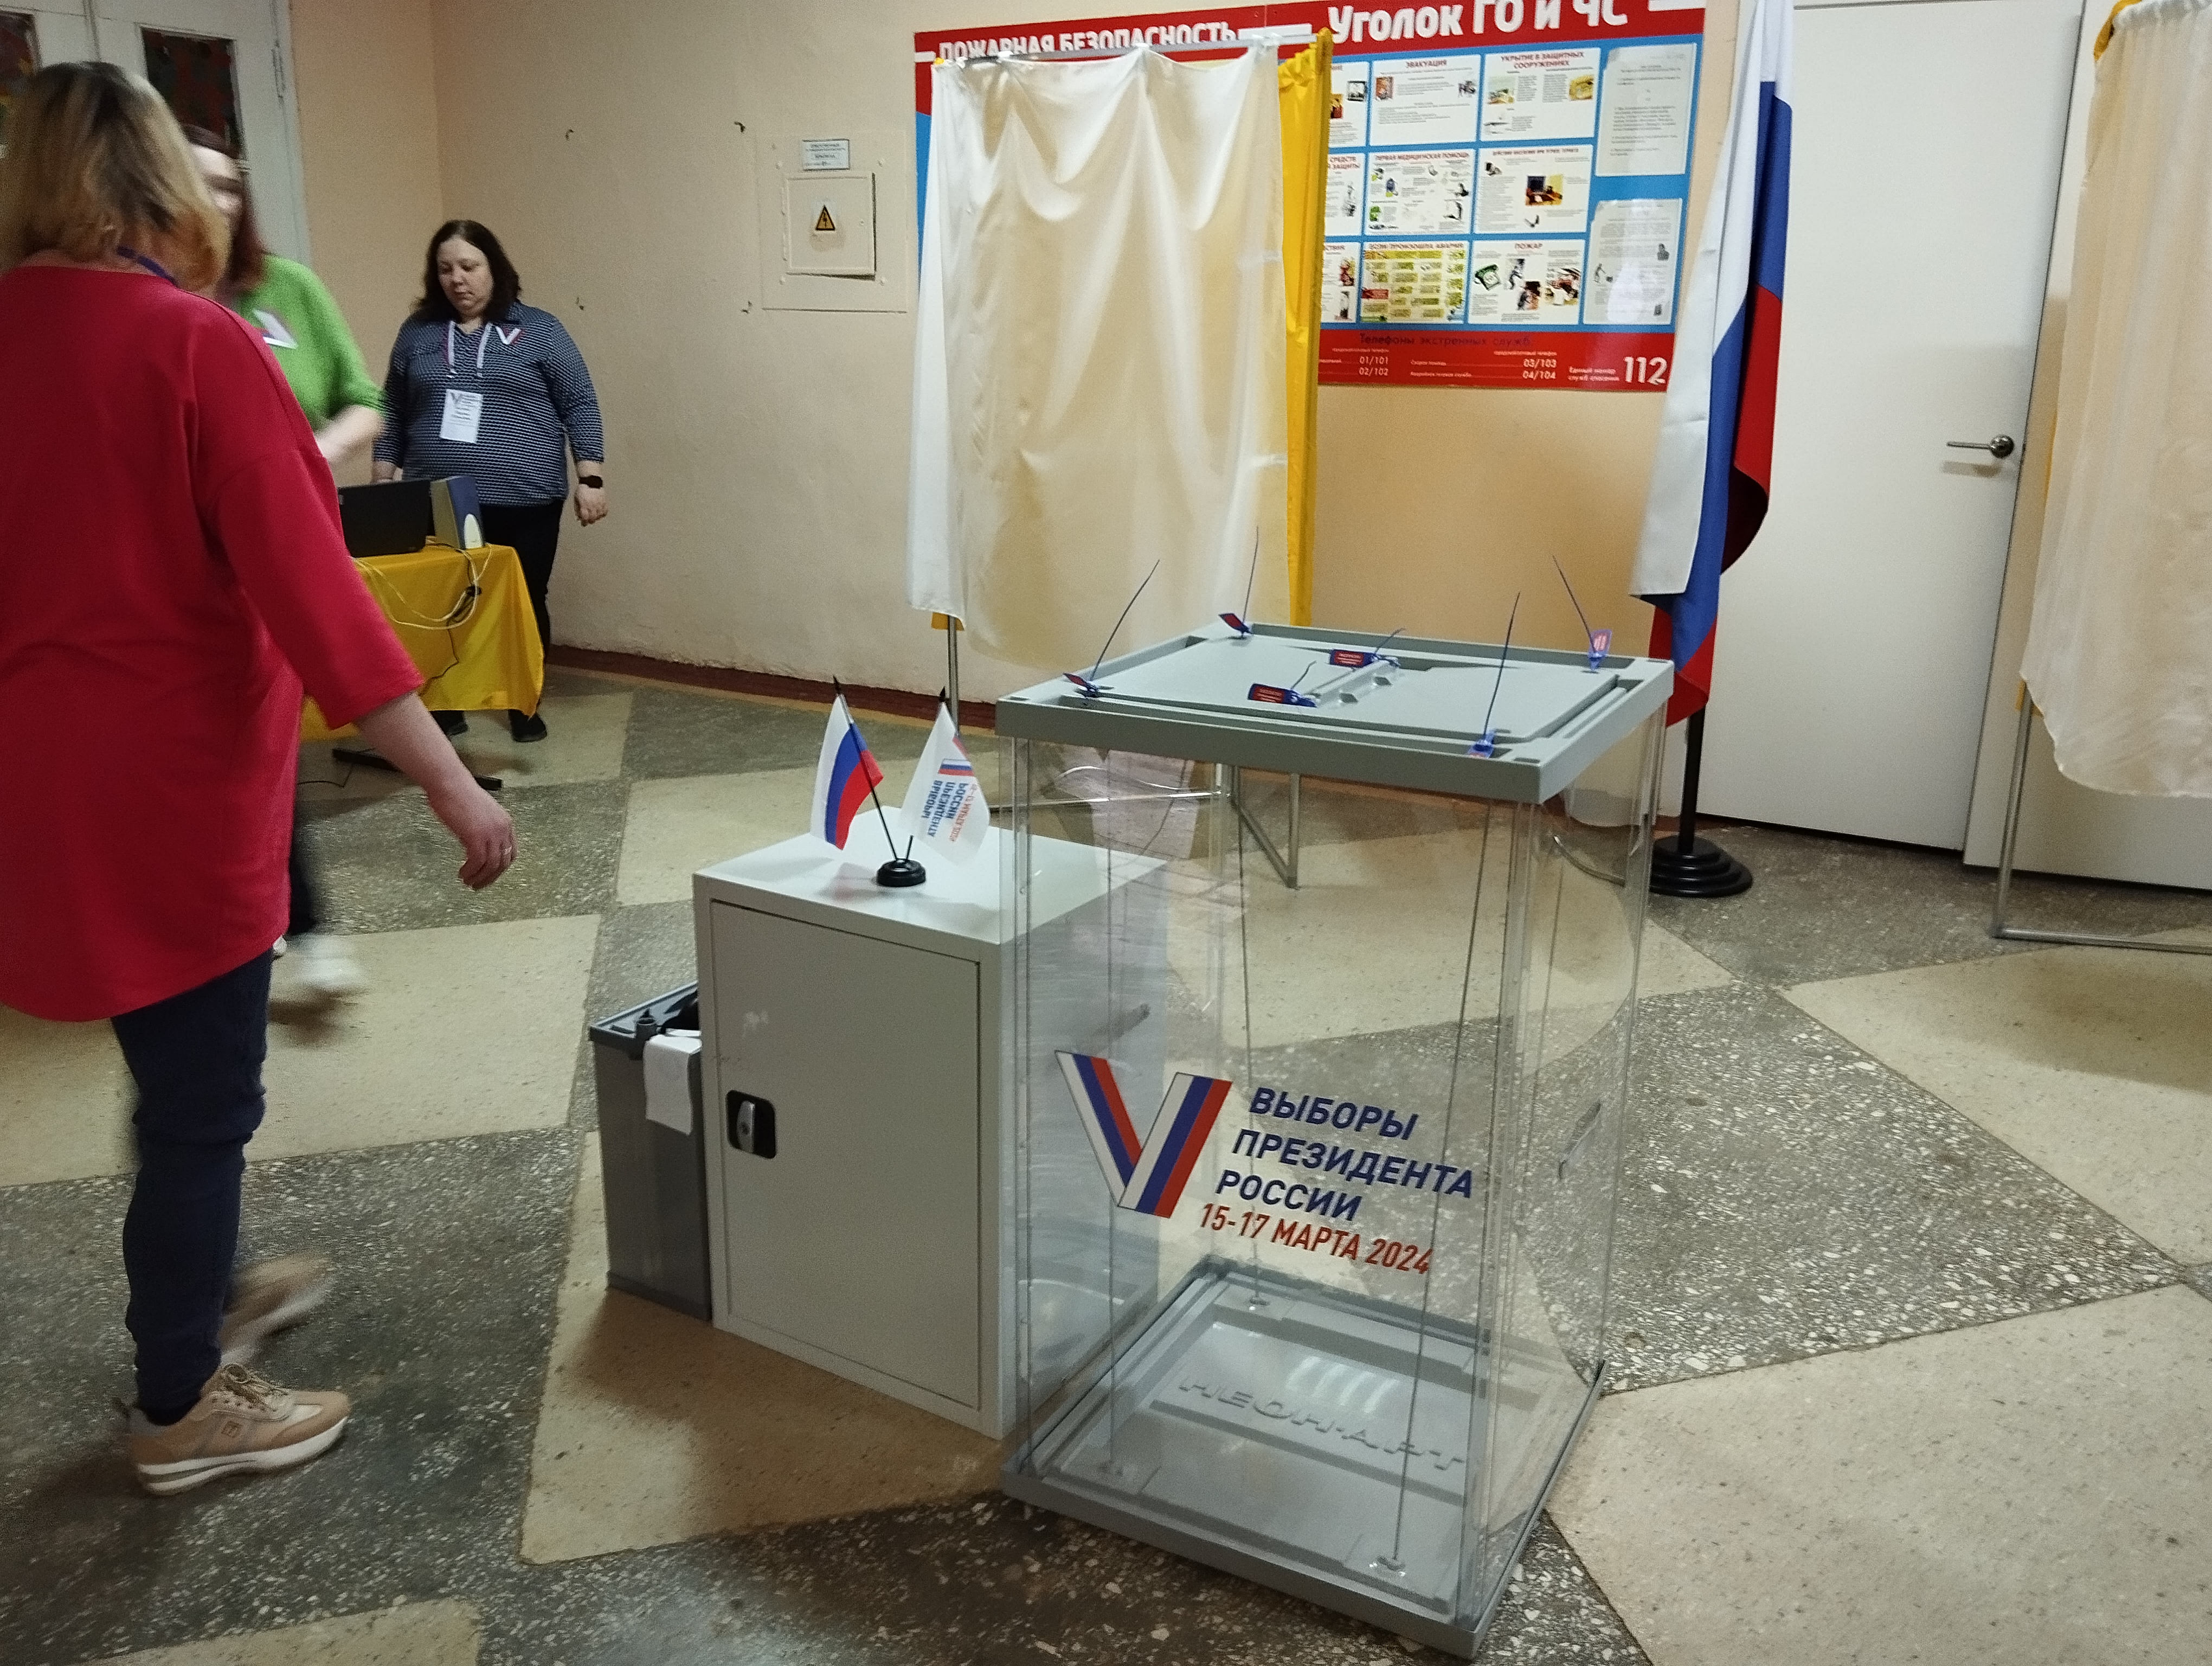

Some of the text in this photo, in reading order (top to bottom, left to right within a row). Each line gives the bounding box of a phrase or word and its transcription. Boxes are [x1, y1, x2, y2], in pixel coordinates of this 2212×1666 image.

[1328, 4, 1463, 43] Уголок
[1472, 0, 1524, 34] ГО
[1573, 0, 1628, 27] ЧС
[939, 21, 1237, 60] ПОЖАРНАЯ БЕЗОПАСНОСТЬ
[1406, 59, 1447, 68] ЭВАКУАЦИЯ
[1360, 332, 1530, 347] Телефоны экстренных служб
[1359, 356, 1388, 366] 01/101
[1359, 367, 1388, 376] 02/102
[1522, 370, 1557, 381] 04/104
[1523, 358, 1557, 369] 03/103
[1623, 356, 1668, 385] 112
[1249, 1087, 1419, 1141] ВЫБОРЫ
[1232, 1128, 1473, 1199] ПРЕЗИДЕНТА
[1215, 1169, 1362, 1222] РОССИИ
[1200, 1202, 1433, 1275] 15-17 МАРТА 2024
